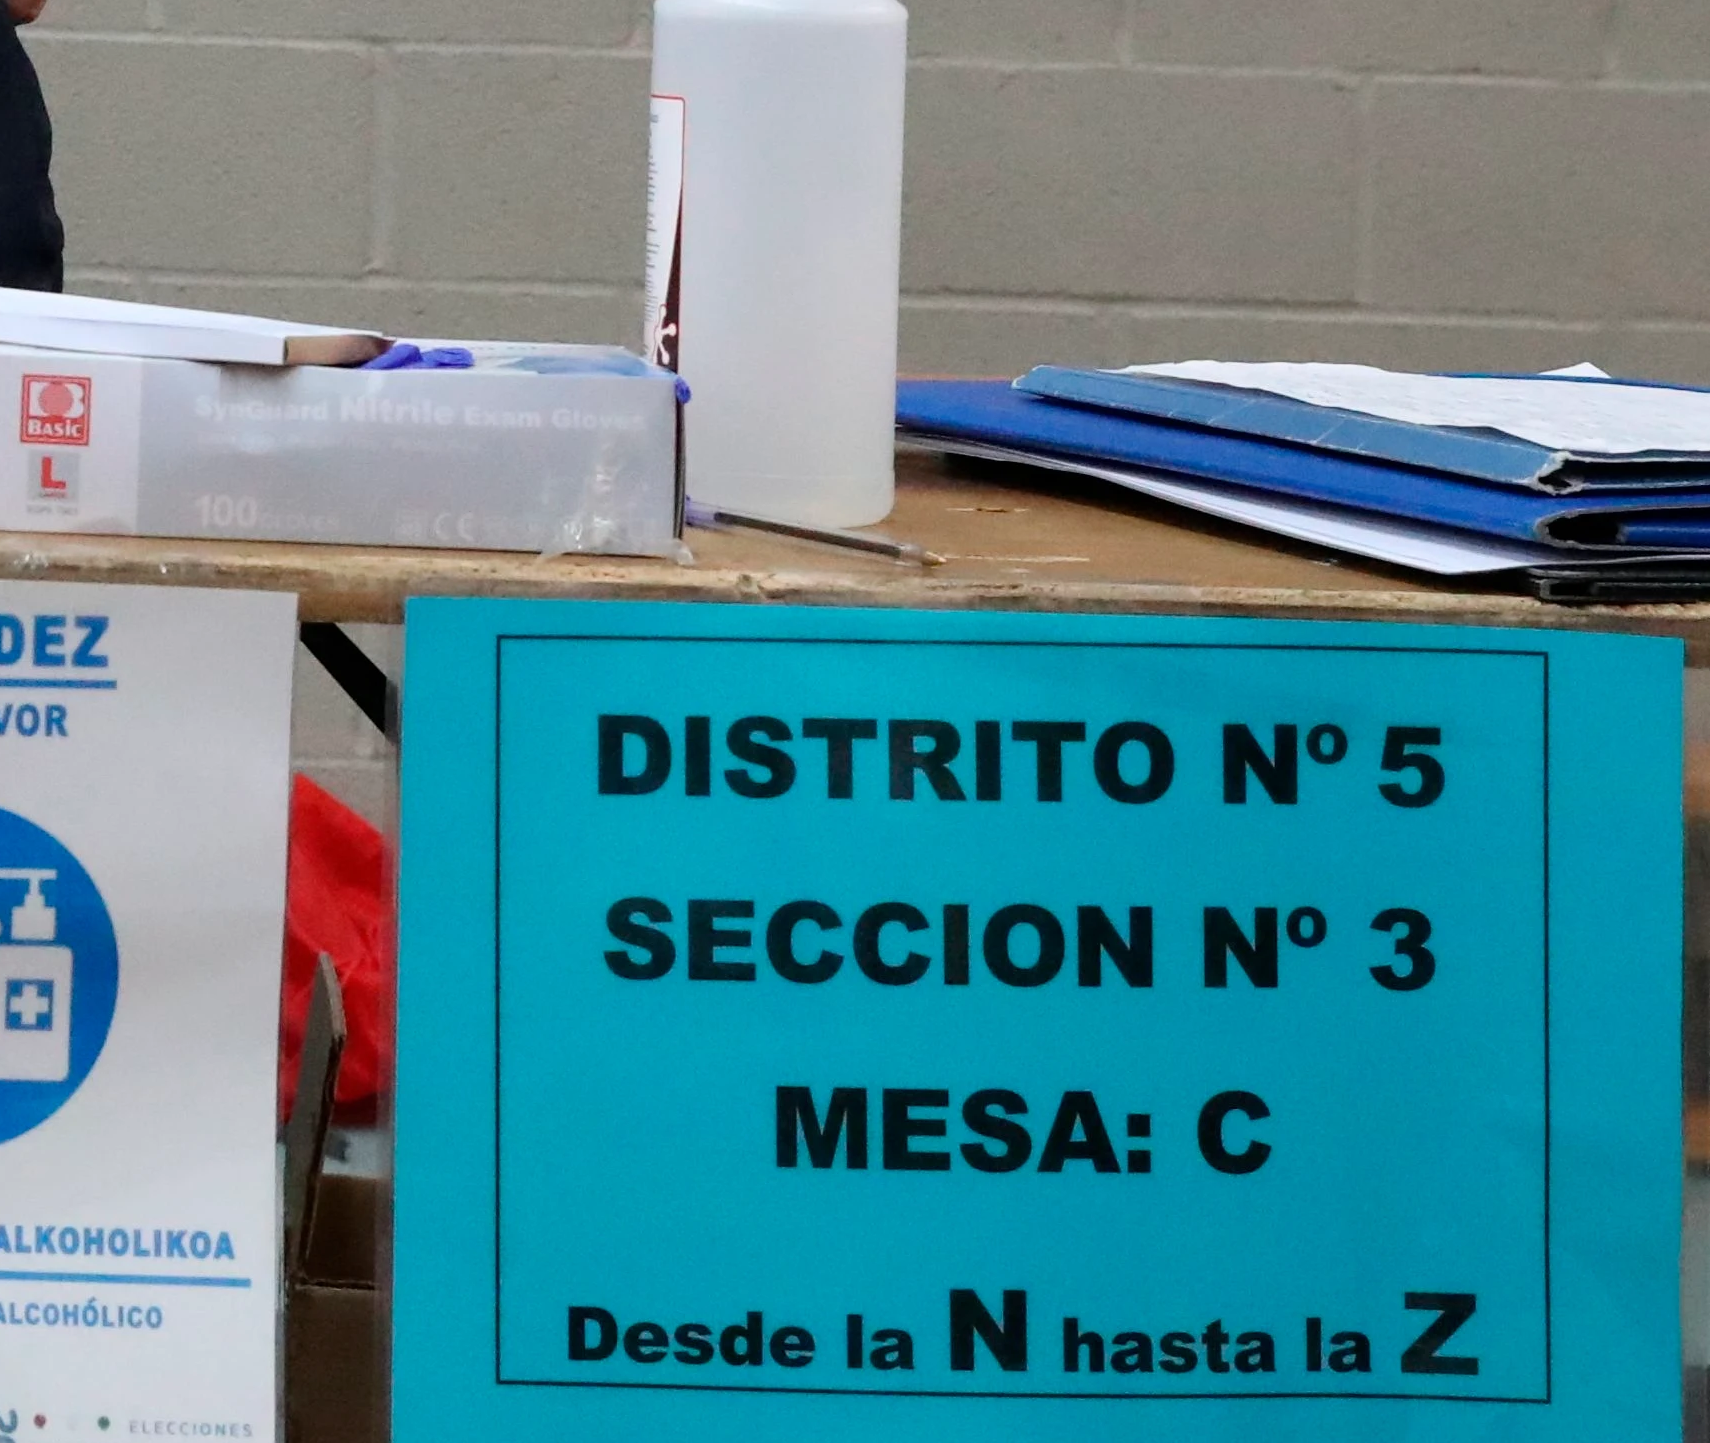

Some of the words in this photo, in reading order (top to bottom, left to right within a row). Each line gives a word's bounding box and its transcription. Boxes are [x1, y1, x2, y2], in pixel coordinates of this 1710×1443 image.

[340, 395, 454, 426] Nitrile
[463, 405, 542, 429] Exam
[551, 406, 648, 431] Gloves
[40, 456, 67, 490] L
[194, 494, 258, 529] 100
[598, 715, 1174, 804] DISTRITO
[1379, 726, 1444, 808] 5
[605, 897, 1153, 988] SECCION
[1370, 908, 1435, 991] 3
[777, 1086, 1151, 1173] MESA:
[1198, 1091, 1271, 1174] C
[568, 1306, 815, 1367] Desde
[847, 1314, 914, 1370] la
[950, 1289, 1027, 1371] N
[1063, 1318, 1275, 1373] hasta
[1306, 1317, 1371, 1372] la
[1401, 1292, 1478, 1375] Z
[129, 1421, 252, 1438] ELECCIONES
